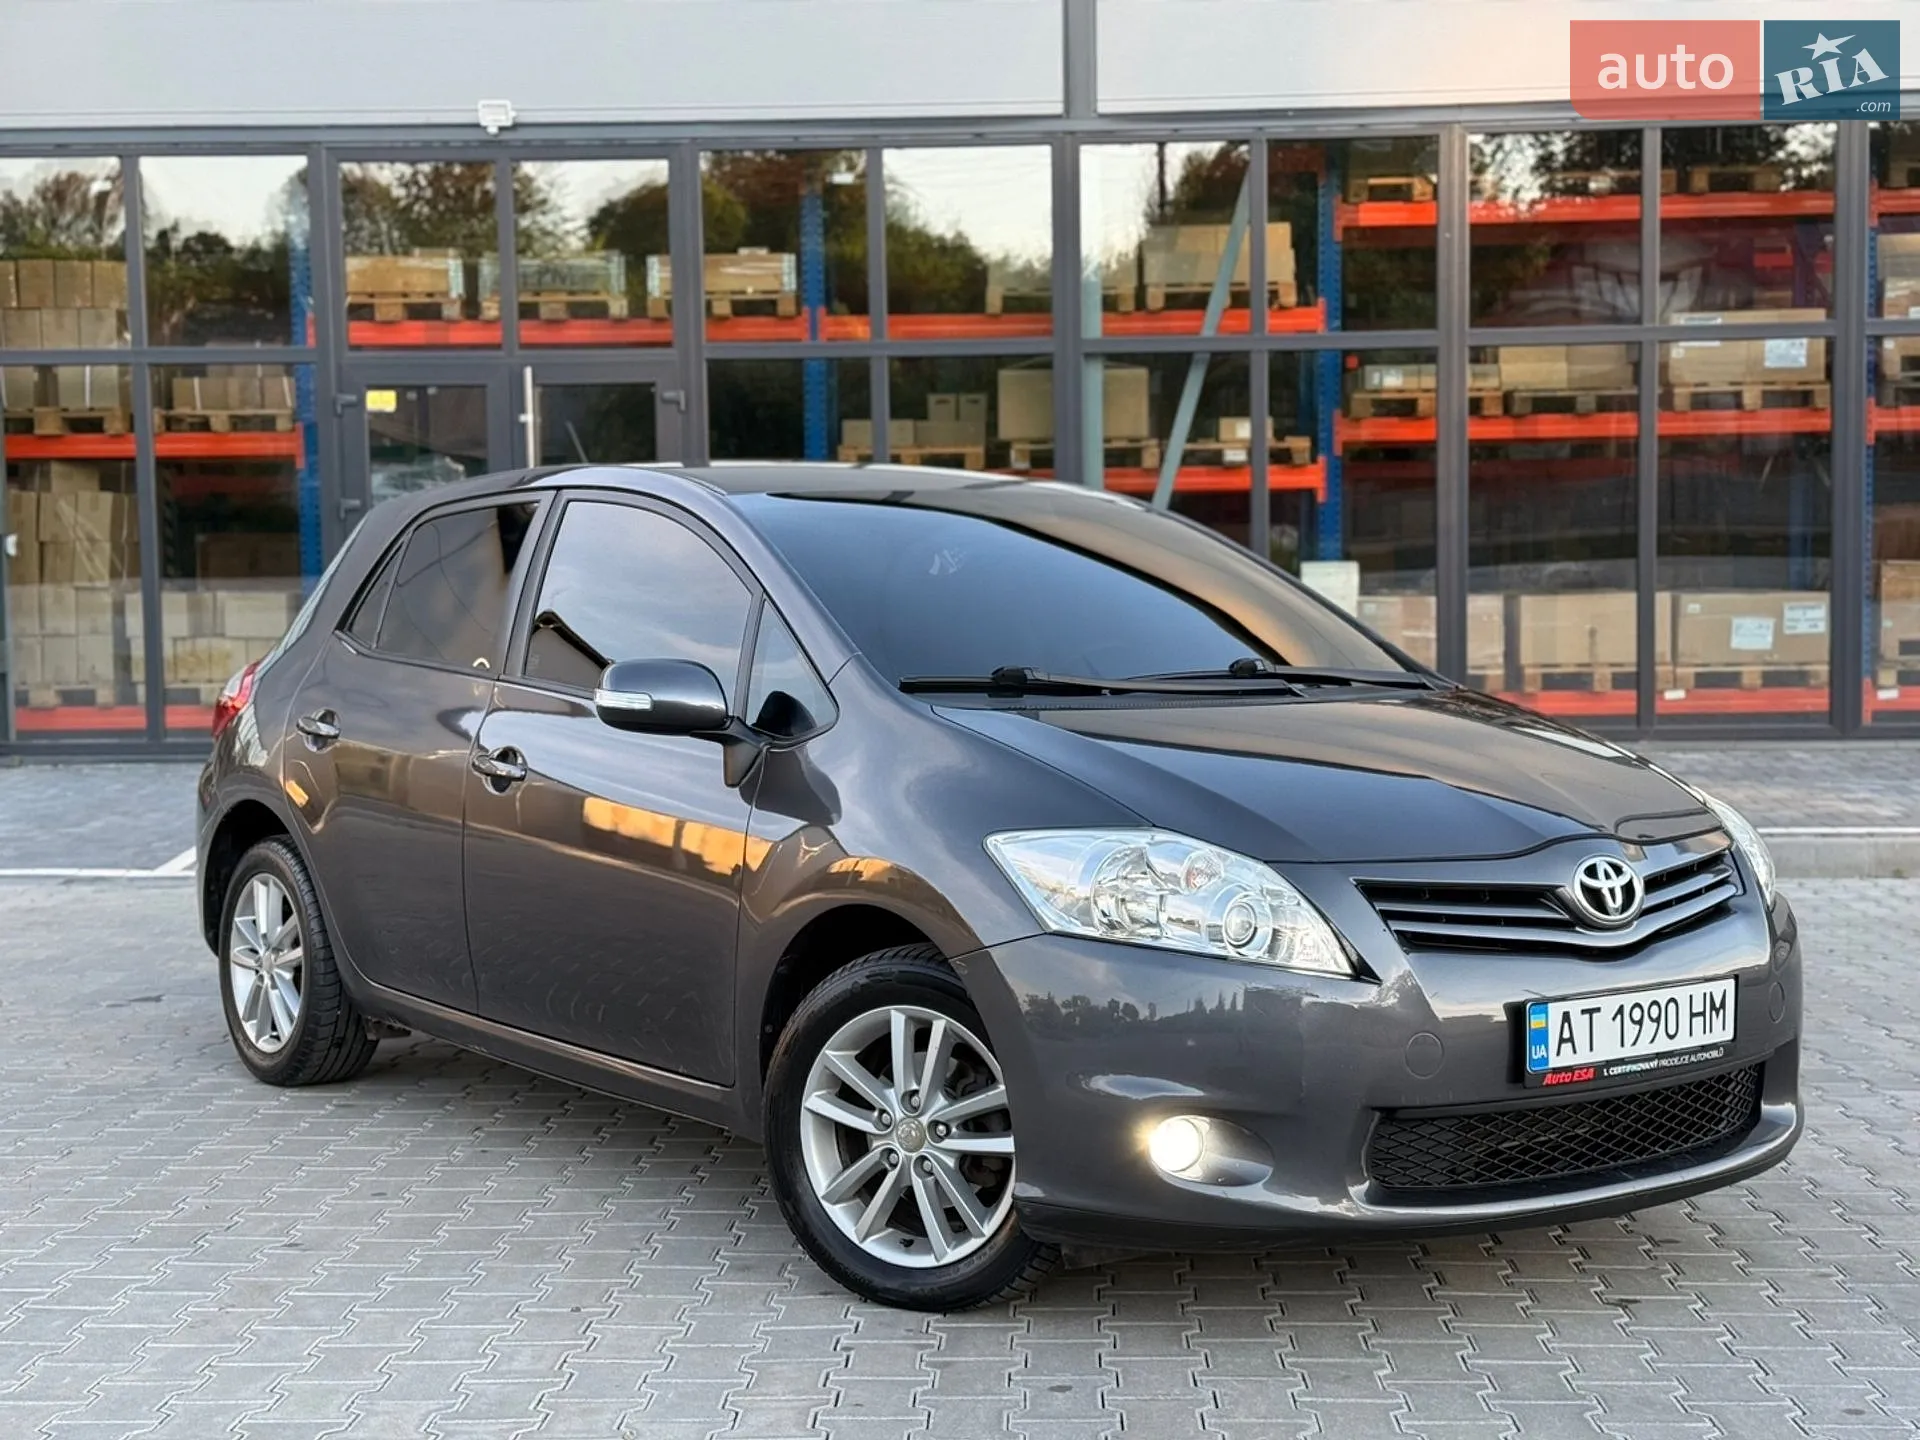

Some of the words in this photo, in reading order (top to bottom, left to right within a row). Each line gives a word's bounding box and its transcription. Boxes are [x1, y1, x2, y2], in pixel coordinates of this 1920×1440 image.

[1556, 1006, 1601, 1057] AT
[1612, 996, 1679, 1048] 1990
[1689, 988, 1727, 1037] HM
[1531, 1044, 1548, 1060] UA
[1572, 1067, 1595, 1082] ESA
